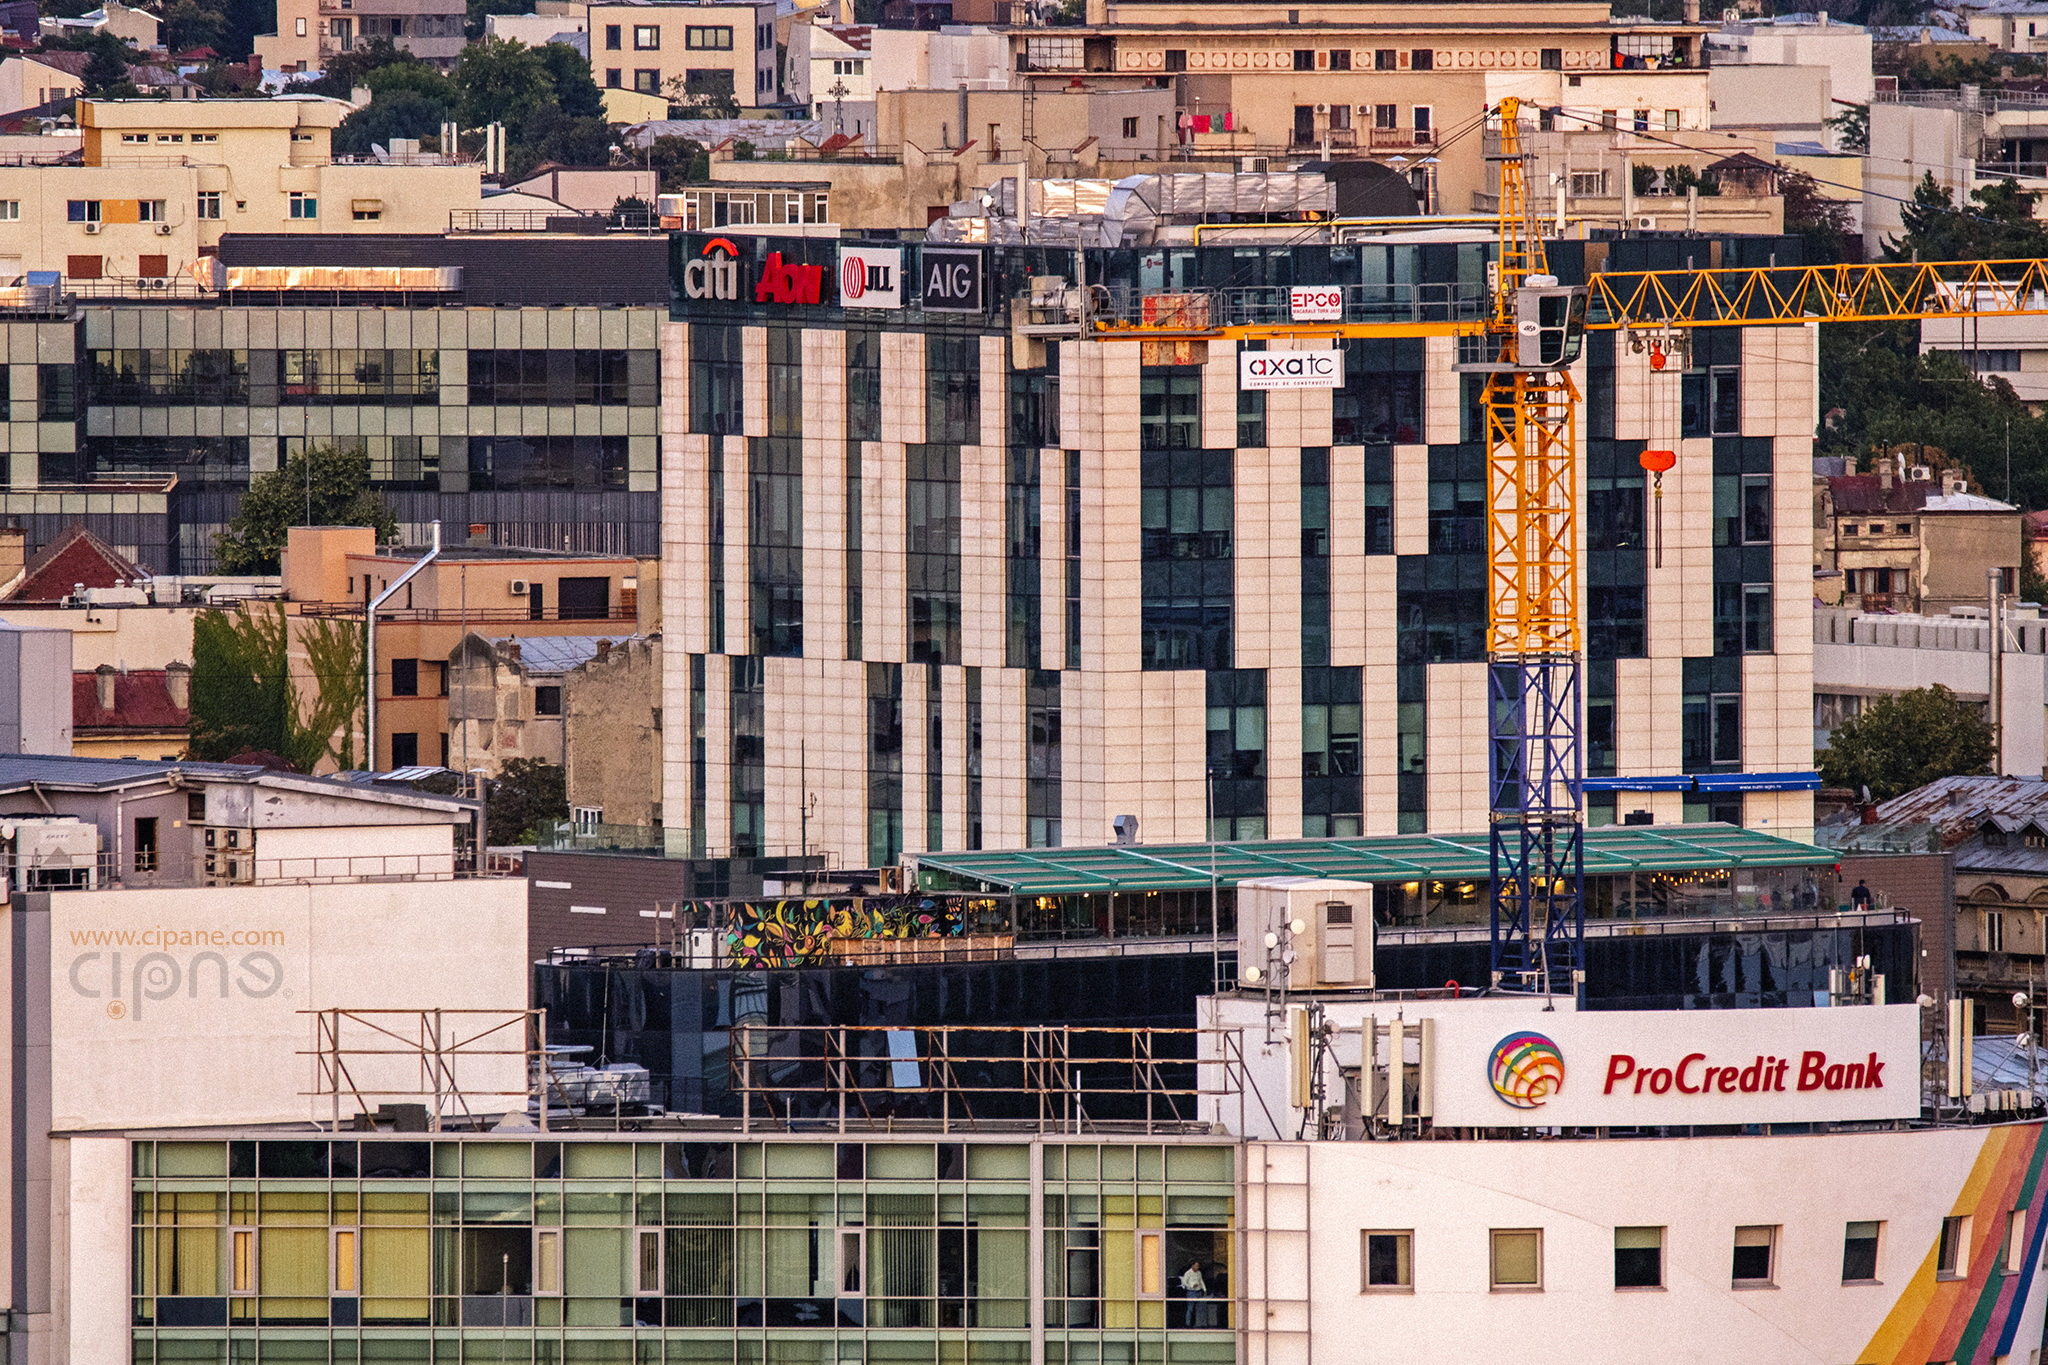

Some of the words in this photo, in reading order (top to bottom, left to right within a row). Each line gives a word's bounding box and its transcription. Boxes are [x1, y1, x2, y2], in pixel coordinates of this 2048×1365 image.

[684, 246, 737, 300] citi
[863, 265, 894, 291] JLL
[927, 263, 971, 298] AIG
[1292, 293, 1340, 307] EPCO
[1603, 1053, 1789, 1094] ProCredit
[1796, 1050, 1885, 1091] Bank
